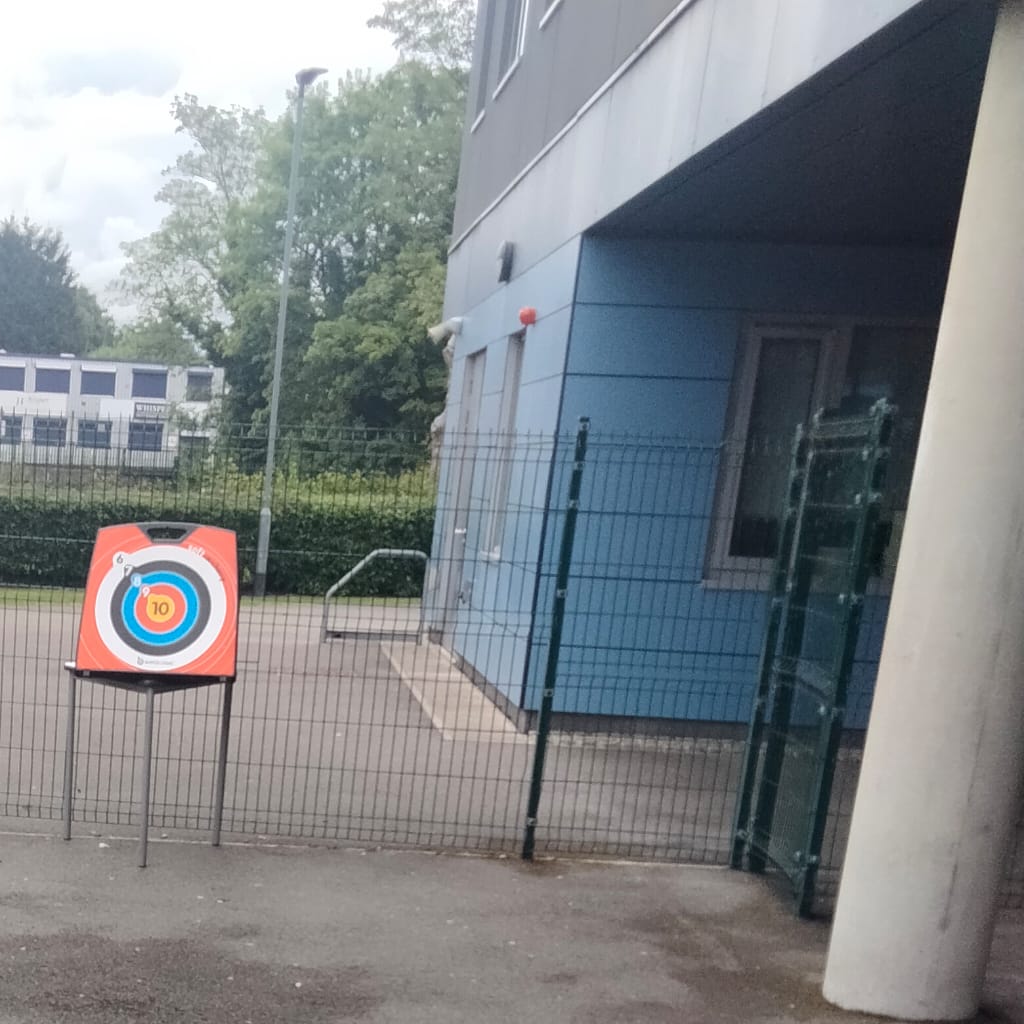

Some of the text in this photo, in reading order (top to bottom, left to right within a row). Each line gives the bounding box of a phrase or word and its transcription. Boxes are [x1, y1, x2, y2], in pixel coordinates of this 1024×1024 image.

[116, 554, 124, 564] 6
[125, 565, 133, 576] 7
[142, 586, 150, 597] 9
[152, 602, 169, 615] 10
